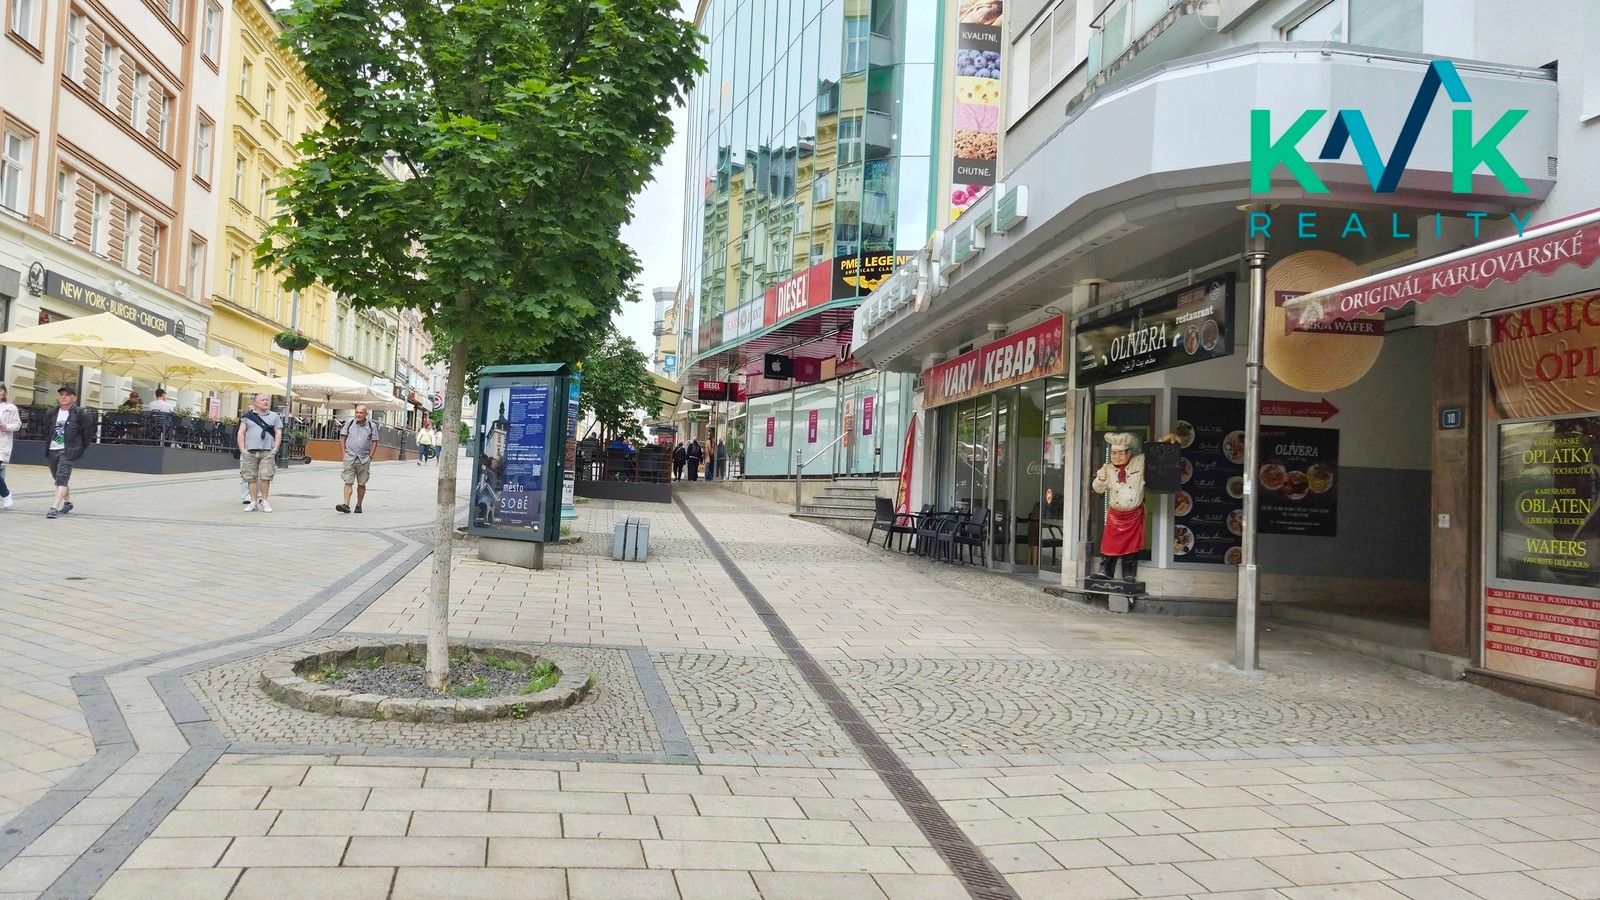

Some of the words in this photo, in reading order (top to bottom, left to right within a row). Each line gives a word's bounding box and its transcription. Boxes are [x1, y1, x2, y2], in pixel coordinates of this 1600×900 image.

[1340, 276, 1422, 312] ORIGINÁL
[1431, 229, 1583, 290] KARLOVARSKÉ
[778, 274, 807, 318] DIESEL
[60, 280, 83, 301] NEW
[85, 289, 107, 311] YORK
[110, 299, 138, 322] BURGER
[140, 311, 168, 333] CHICKEN
[1175, 305, 1214, 325] restaurant
[1334, 321, 1374, 333] WAFER
[1110, 322, 1167, 362] OLIVERA
[943, 358, 977, 398] VARY
[983, 336, 1036, 385] KEBAB
[703, 381, 721, 390] DIESEL
[1522, 447, 1592, 465] OPLATKY
[503, 481, 524, 493] město
[500, 495, 528, 510] SOBĚ
[1521, 498, 1592, 514] OBLATEN
[1526, 517, 1558, 525] LIEBLINGS
[1560, 517, 1585, 526] LECKER
[1526, 538, 1587, 557] WAFERS
[1554, 558, 1589, 569] DELICIOUS
[1504, 609, 1524, 618] YEARS
[1525, 611, 1534, 619] OF
[1525, 649, 1538, 657] DES
